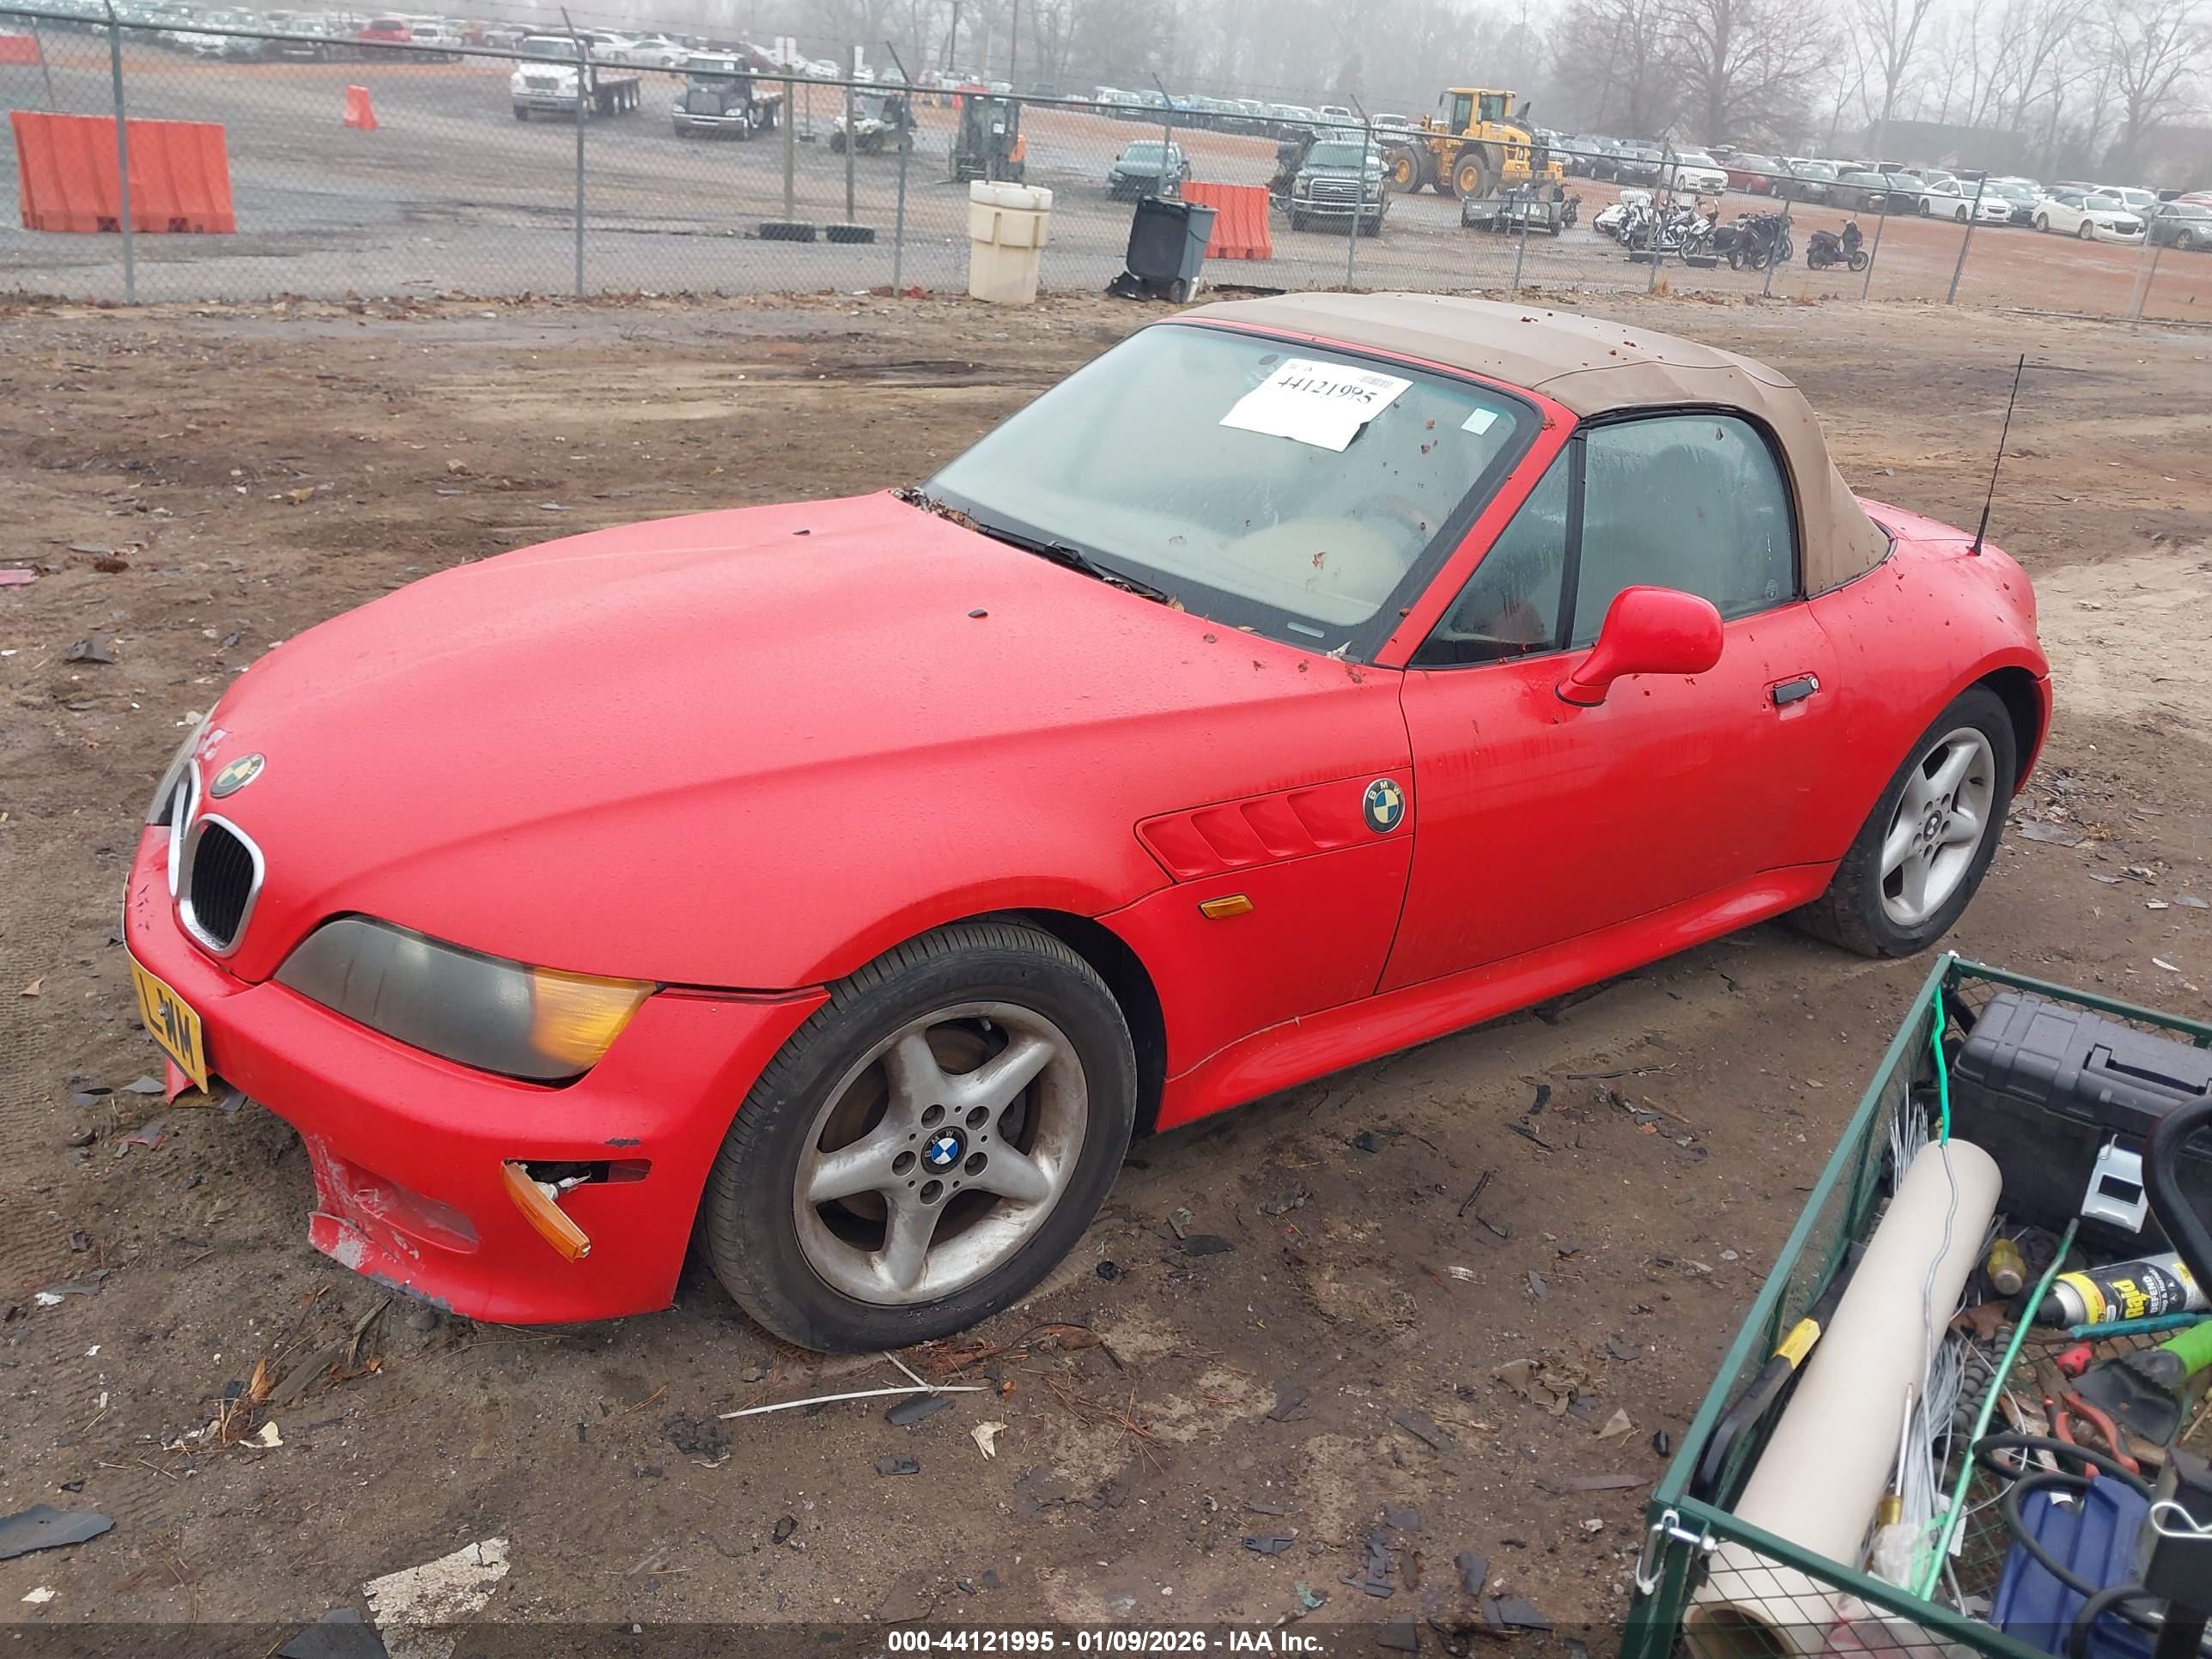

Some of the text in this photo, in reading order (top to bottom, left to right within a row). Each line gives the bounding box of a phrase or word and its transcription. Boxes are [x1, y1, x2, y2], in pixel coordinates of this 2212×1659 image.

[1277, 375, 1379, 404] 44121995
[1367, 780, 1401, 800] BMW
[924, 1130, 955, 1158] BMW
[2112, 1279, 2148, 1319] Raid
[2142, 1274, 2159, 1315] DEFEND
